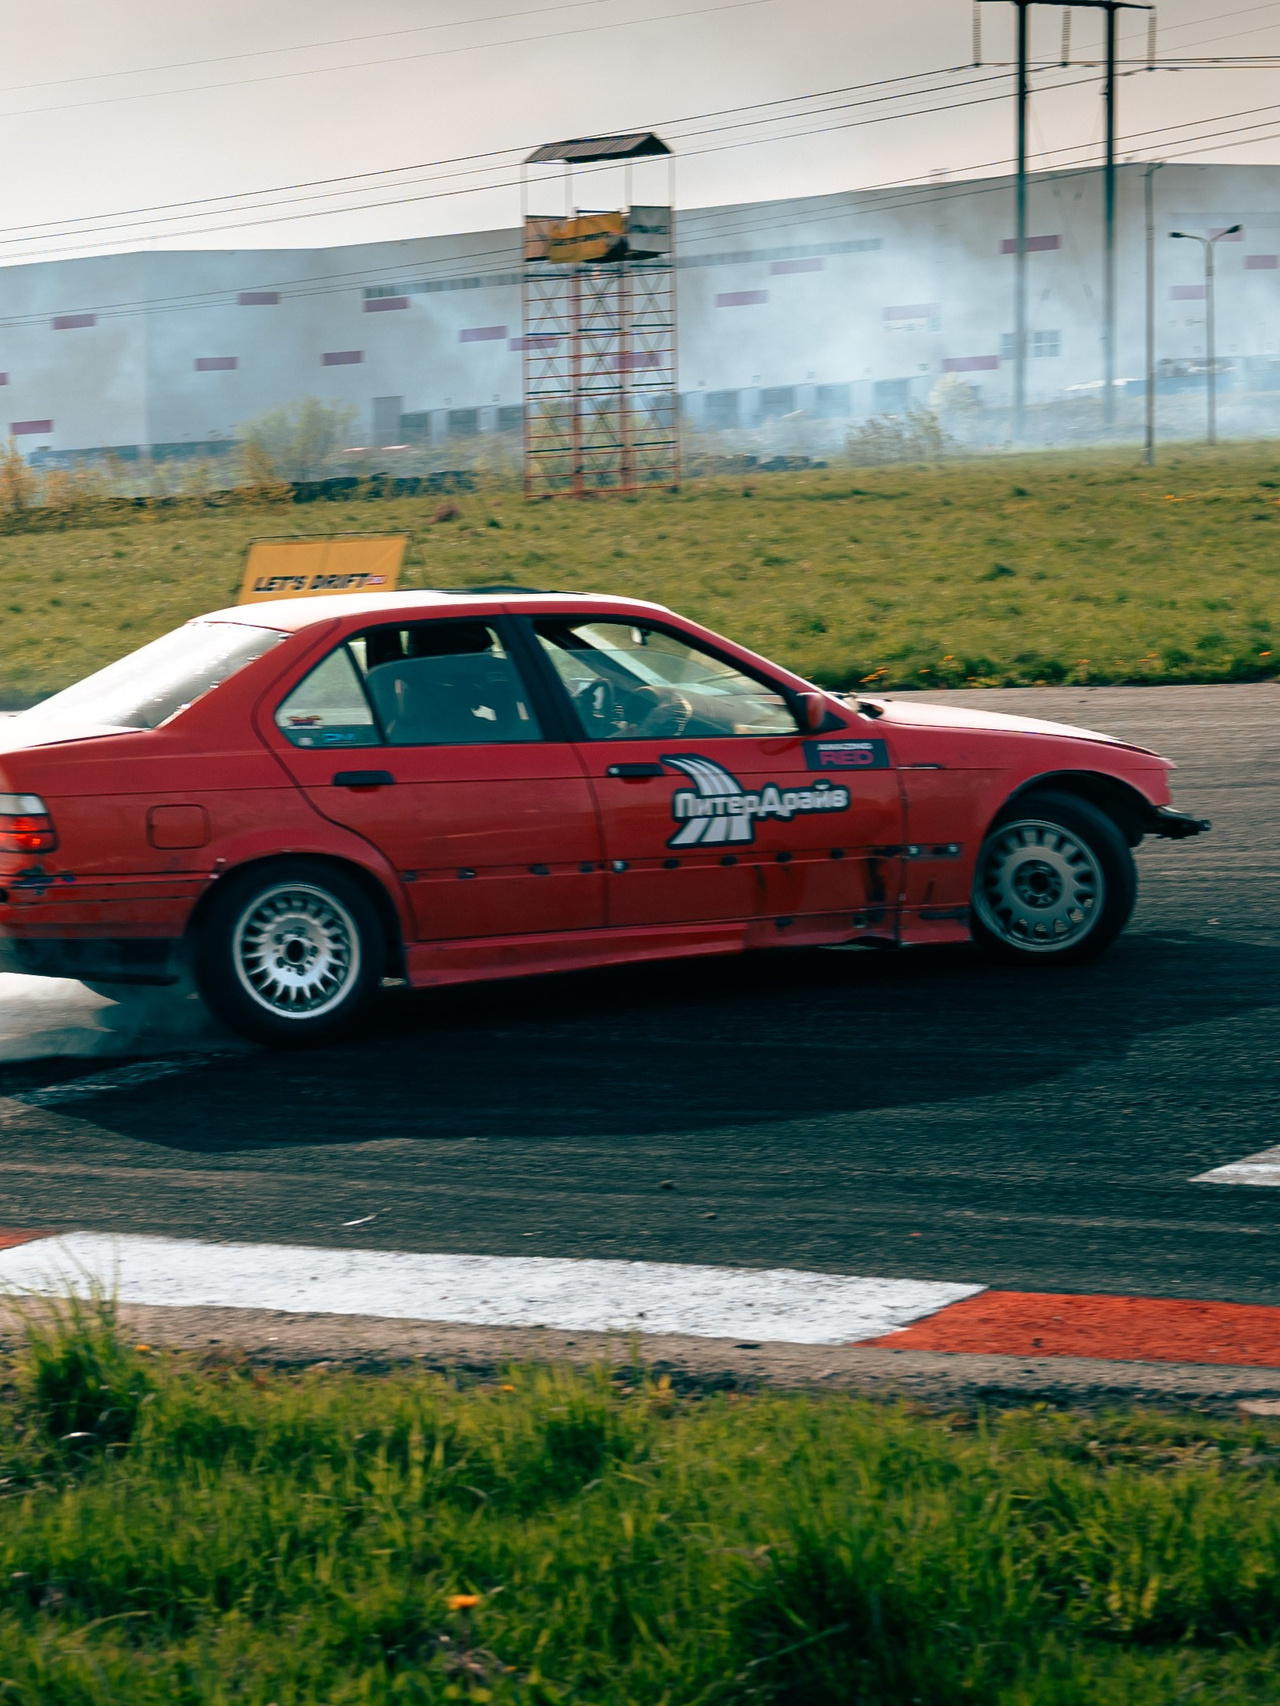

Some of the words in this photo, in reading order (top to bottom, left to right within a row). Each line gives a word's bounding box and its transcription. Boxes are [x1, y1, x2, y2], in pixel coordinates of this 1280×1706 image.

[253, 575, 307, 592] LET'S
[309, 573, 371, 590] DRIFT
[819, 750, 875, 766] RED
[675, 783, 849, 818] ПитерДрайв
